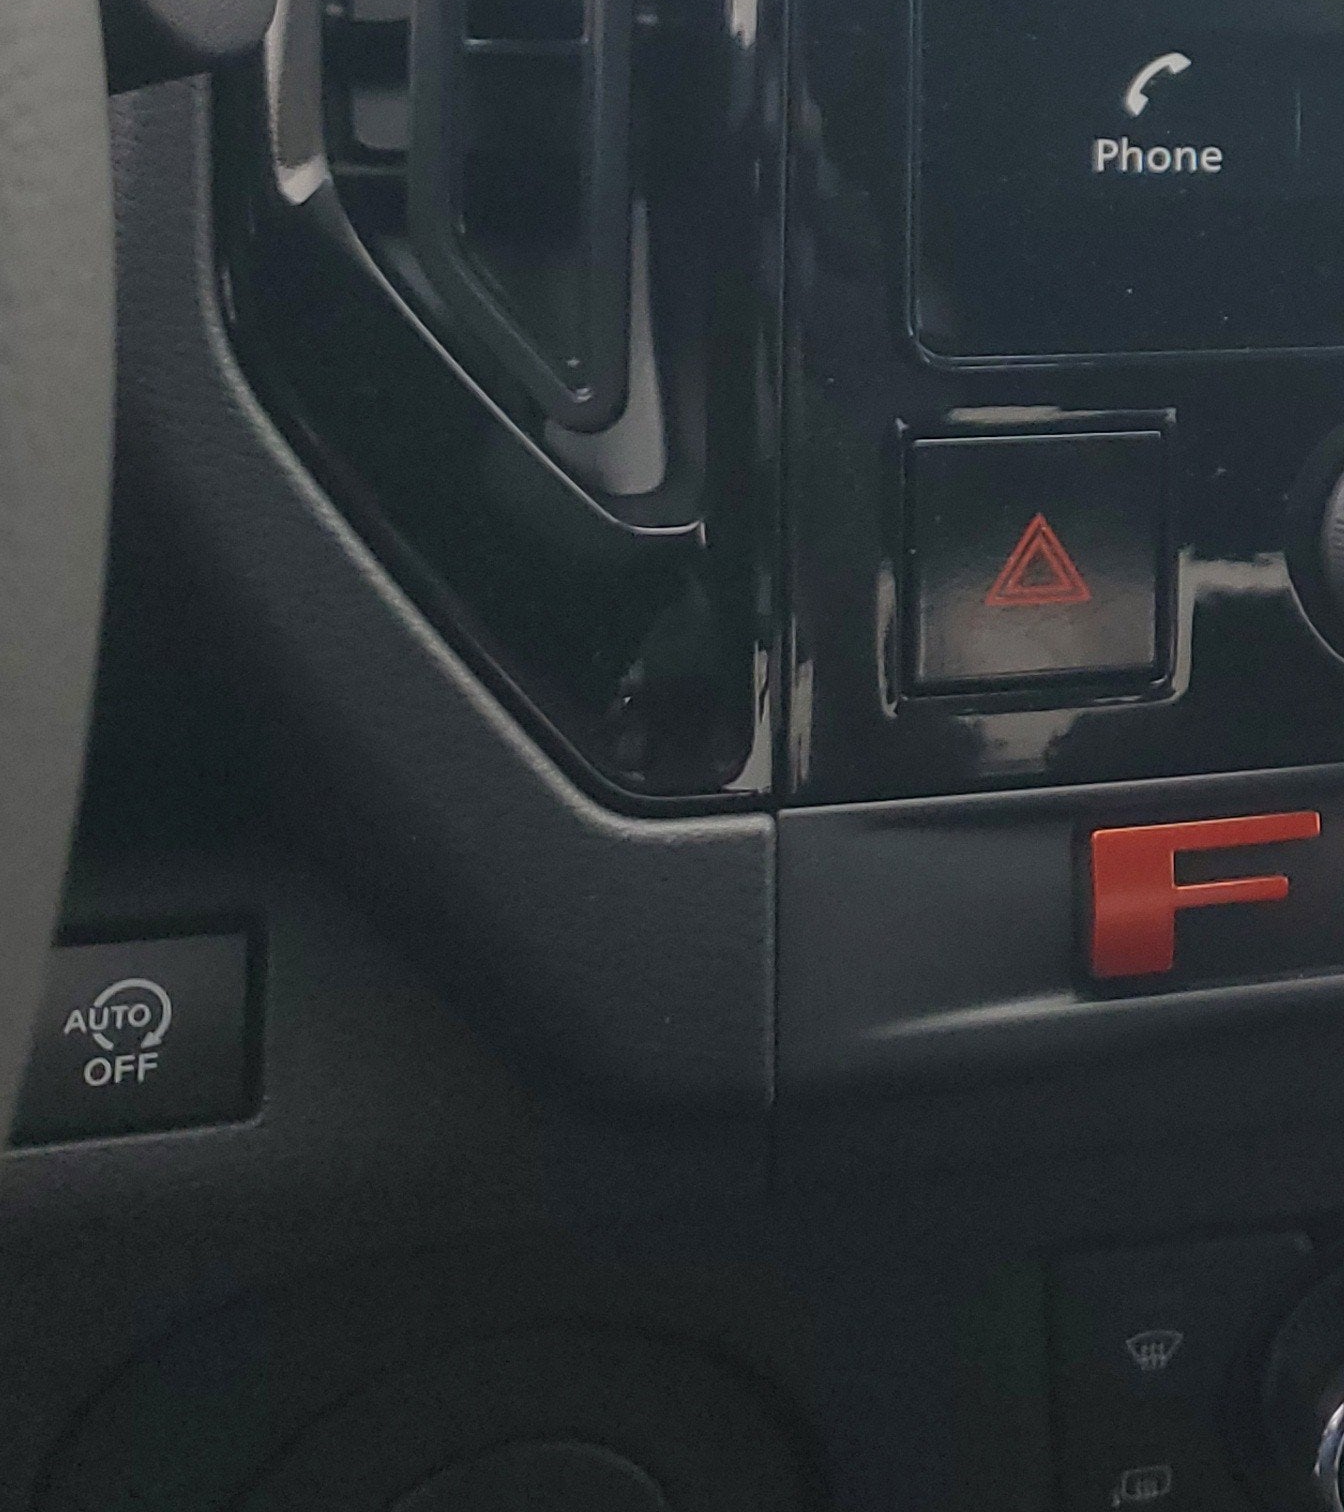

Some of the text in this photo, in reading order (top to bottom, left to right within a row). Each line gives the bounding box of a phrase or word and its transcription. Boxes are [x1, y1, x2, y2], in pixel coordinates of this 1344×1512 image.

[1093, 137, 1223, 173] Phone
[64, 1003, 151, 1035] AUTO
[84, 1052, 159, 1087] OFF
